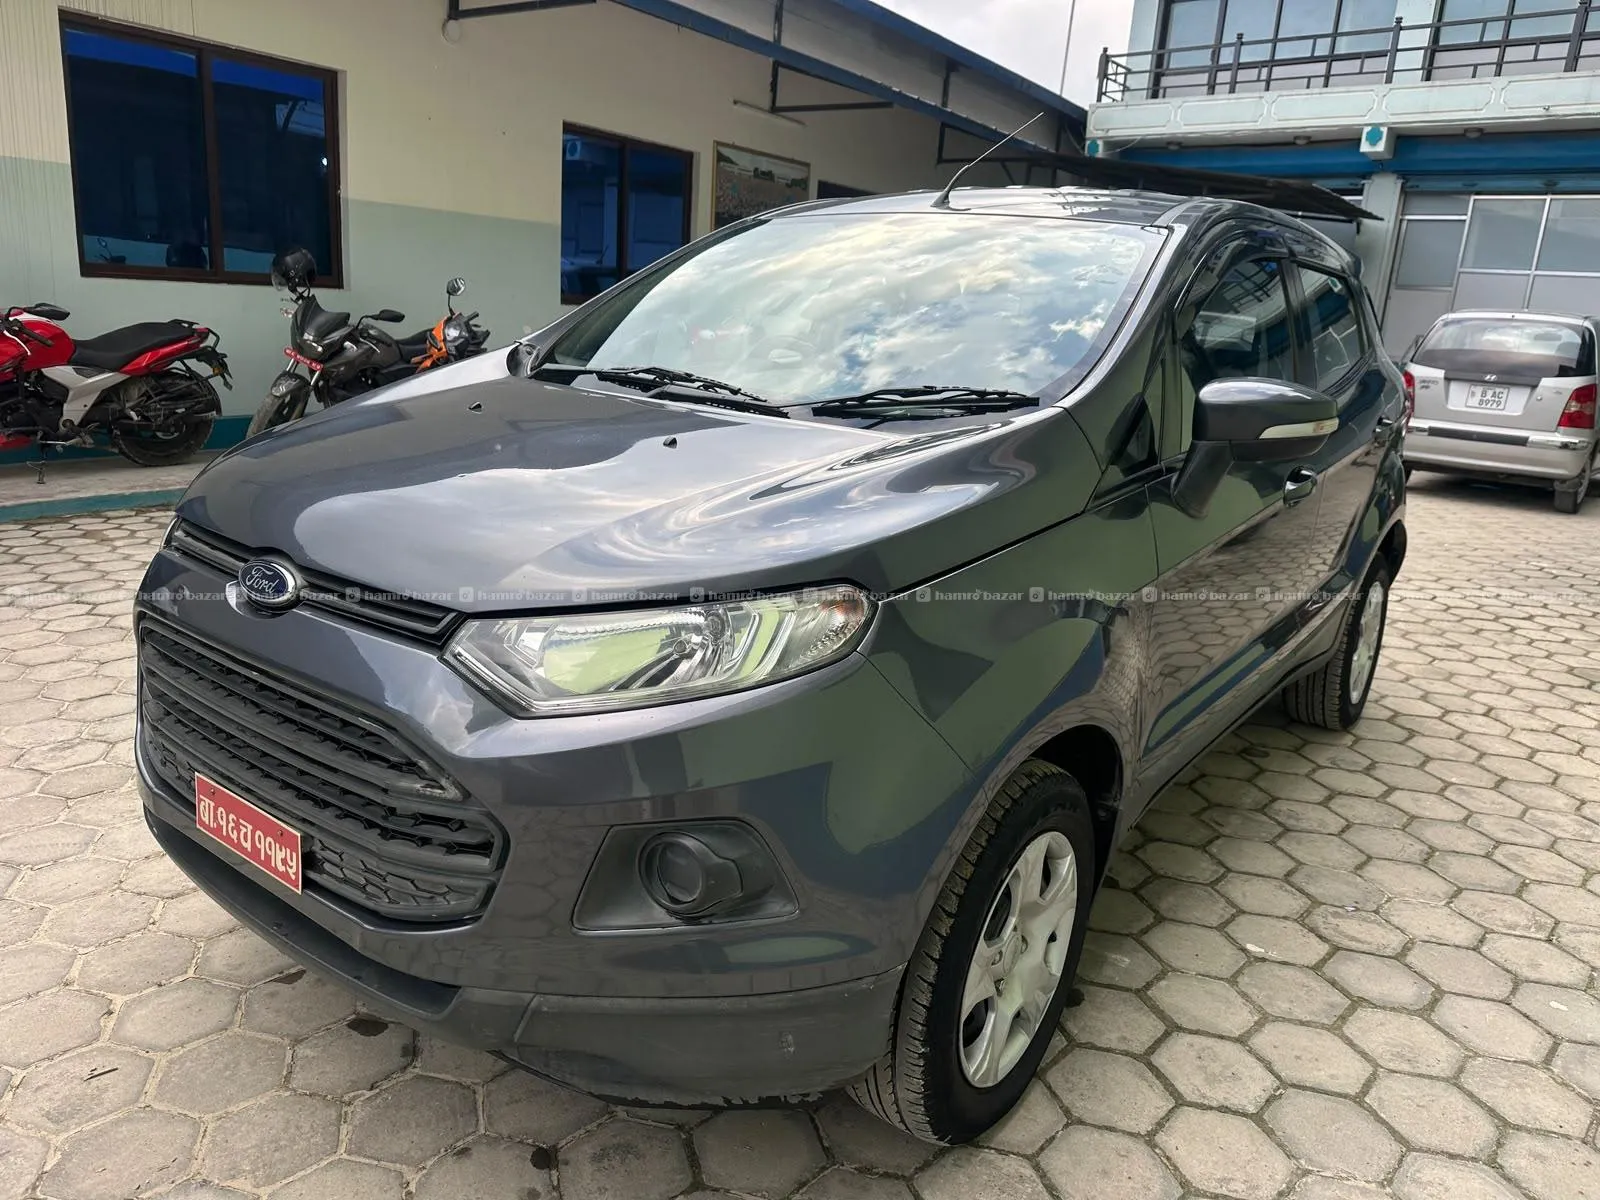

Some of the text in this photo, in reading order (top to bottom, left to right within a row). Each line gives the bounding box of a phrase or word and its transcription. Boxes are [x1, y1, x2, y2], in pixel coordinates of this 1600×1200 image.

[1480, 390, 1504, 400] B AC
[246, 566, 280, 593] Ford
